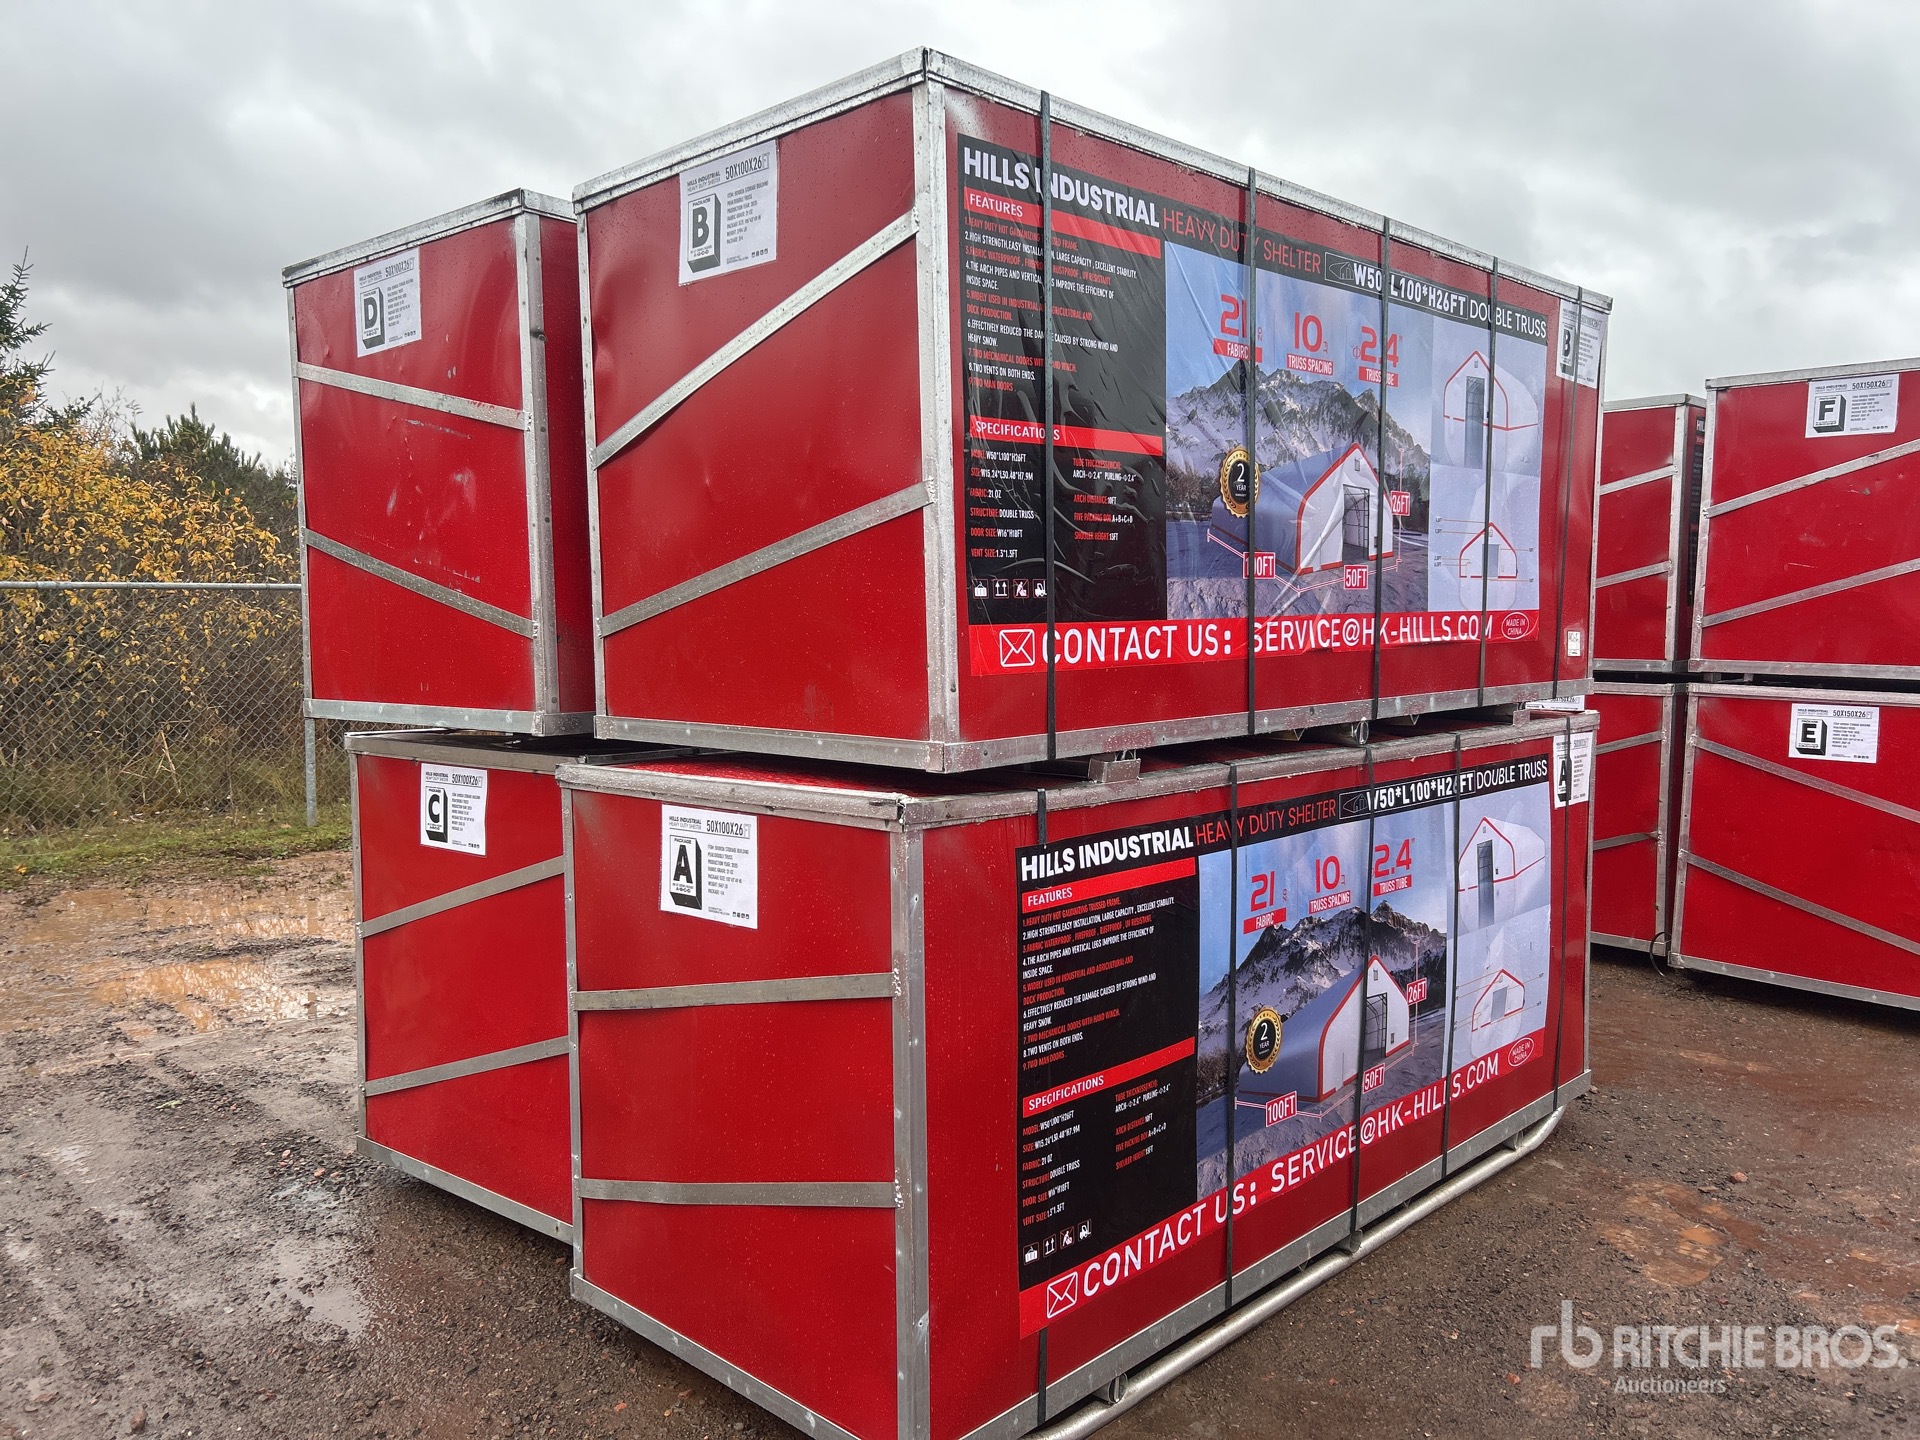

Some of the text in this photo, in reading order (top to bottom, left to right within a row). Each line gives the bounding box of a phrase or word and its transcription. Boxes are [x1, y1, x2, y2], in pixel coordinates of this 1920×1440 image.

[969, 193, 1023, 217] FEATURES
[692, 206, 710, 249] B
[963, 147, 1030, 190] HILLS
[1163, 208, 1216, 244] HEAVY
[1263, 239, 1321, 274] SHELTER
[1353, 262, 1467, 316] W50L100H26FT
[1515, 313, 1547, 339] TRUSS
[363, 296, 378, 330] D
[1220, 293, 1247, 338] 21
[1294, 311, 1323, 352] 10
[1288, 354, 1333, 374] TRUSS SPACING
[1818, 400, 1836, 421] F
[975, 420, 1060, 440] SPECIFICATIOS
[1237, 463, 1245, 482] 2
[1018, 509, 1035, 519] TRUSS
[1393, 494, 1409, 514] 26FT
[1344, 568, 1367, 587] 50FT
[1042, 625, 1177, 664] CONTACT
[1801, 723, 1817, 743] E
[428, 793, 440, 824] C
[1021, 848, 1076, 881] HILLS
[1078, 826, 1194, 869] INDUSTRIAL
[1195, 816, 1245, 846] HEAVY
[1250, 810, 1285, 835] DUTY
[1288, 798, 1337, 827] SHELTER
[1476, 765, 1516, 790] DOUBLE
[1518, 759, 1548, 780] TRUSS
[673, 844, 693, 884] A
[1315, 855, 1341, 893] 10
[1027, 887, 1073, 907] FEATURES
[1250, 870, 1275, 912] 21
[1379, 876, 1408, 895] TRUSS TUBE
[1310, 891, 1350, 913] TRUSS SPACING
[1408, 979, 1426, 1004] 26FT
[1260, 1022, 1268, 1041] 2
[1259, 1040, 1270, 1049] YEAR
[1364, 1066, 1384, 1091] 50FT
[1028, 1075, 1104, 1111] SPECIFICATIONS
[1267, 1094, 1296, 1124] 100FT
[1083, 1202, 1207, 1297] CONTACT
[1215, 1181, 1257, 1223] US:
